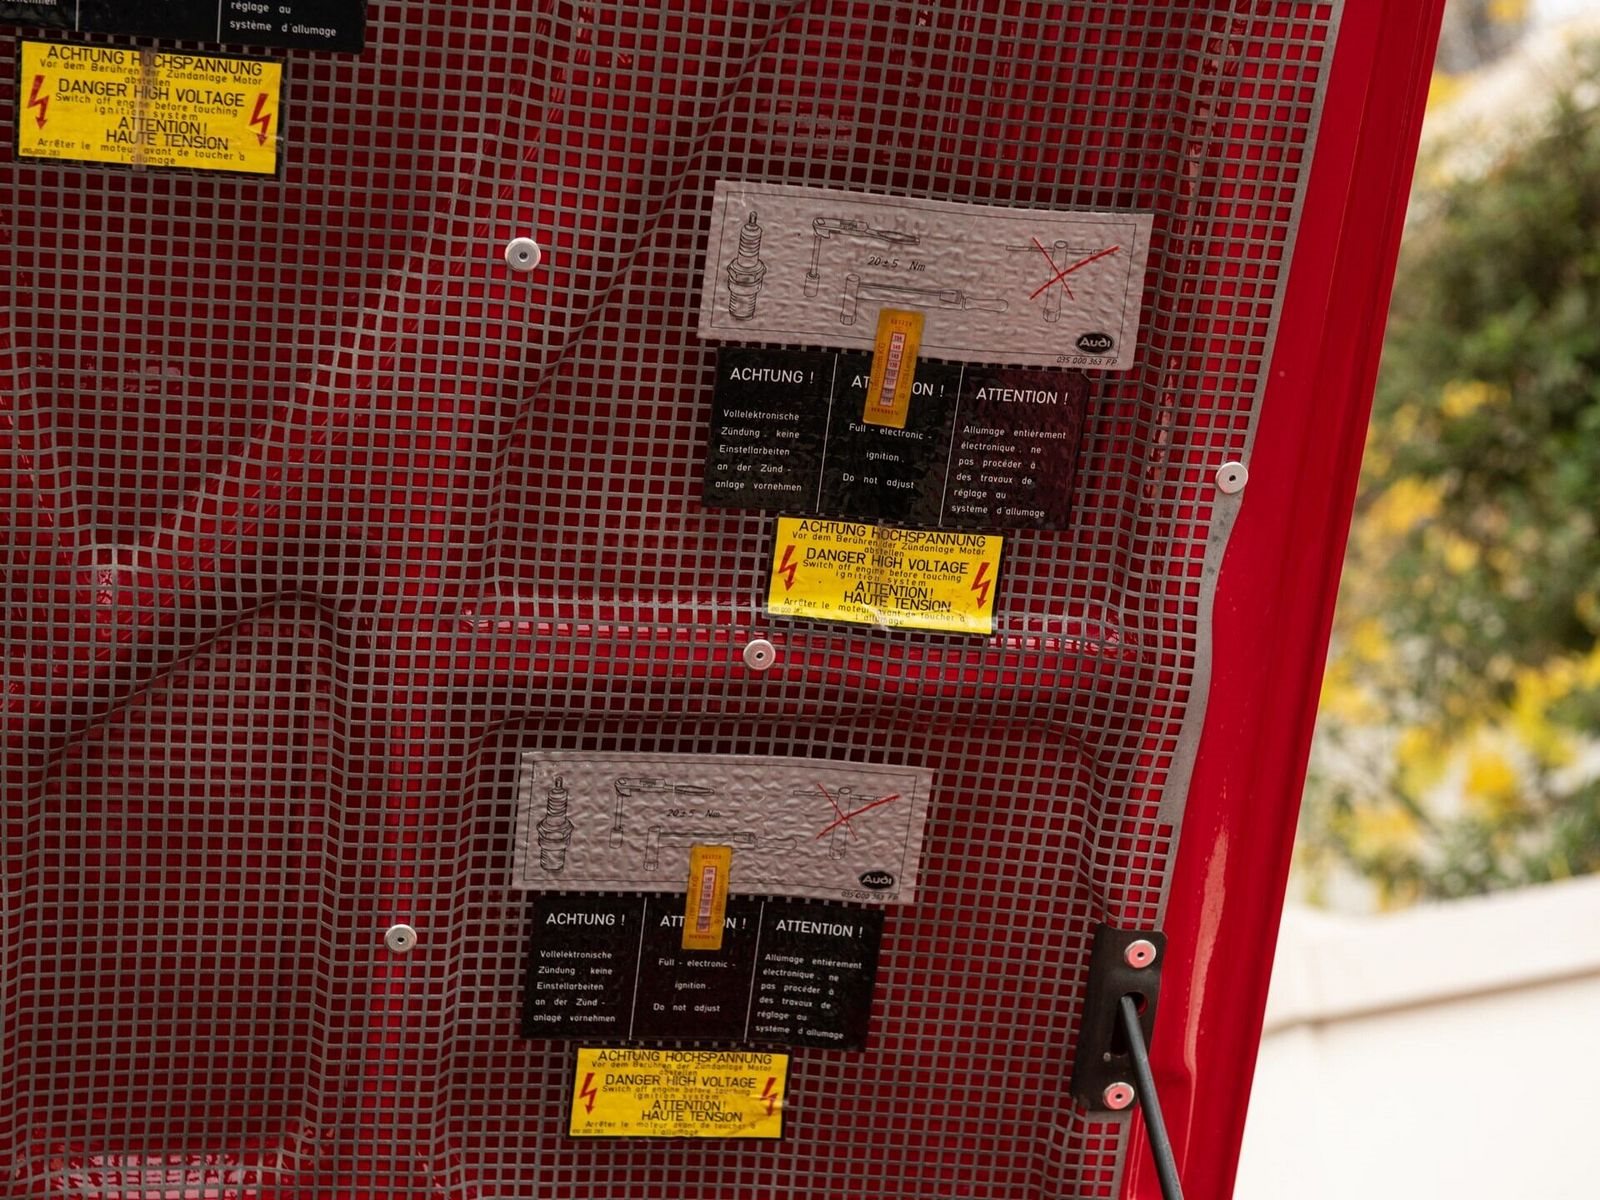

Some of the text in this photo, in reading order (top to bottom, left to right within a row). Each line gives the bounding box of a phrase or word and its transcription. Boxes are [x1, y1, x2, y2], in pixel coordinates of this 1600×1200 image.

[230, 0, 292, 14] réglage au
[230, 20, 272, 31] système
[48, 46, 263, 76] ACHTUNG HOCHSPANNUNG
[40, 58, 57, 68] Vor
[64, 60, 85, 70] dem
[91, 62, 140, 74] Berühren
[167, 70, 228, 84] Zündanlage
[233, 75, 263, 86] Motor
[58, 78, 246, 107] DANGER HIGH VOLTAGE
[56, 92, 91, 104] Switch
[154, 100, 188, 112] before
[194, 104, 238, 117] touching
[153, 110, 198, 121] system
[106, 128, 228, 150] HAUTE TENSION
[38, 138, 76, 149] Arrêter
[82, 141, 91, 150] le
[177, 148, 189, 157] de
[194, 151, 234, 160] toucher
[908, 260, 926, 272] Nm
[1080, 336, 1111, 348] Audi
[730, 367, 804, 384] ACHTUNG
[976, 386, 1058, 404] ATTENTION
[723, 409, 800, 420] Vollelektronische
[776, 430, 800, 438] keine
[963, 425, 1067, 440] Allumage entièrement
[719, 444, 790, 456] Einstellarbeiten
[1030, 446, 1042, 454] ne
[736, 462, 752, 472] der
[958, 458, 974, 466] pas
[982, 458, 1022, 469] procéder
[842, 472, 914, 489] Do not adjust
[956, 472, 1032, 485] des travaux de
[715, 480, 802, 492] anlage vornehmen
[954, 488, 1006, 500] réglage au
[951, 504, 988, 514] système
[799, 520, 986, 548] ACHTUNG HOCHSPANNUNG
[792, 531, 807, 539] Vor
[812, 533, 832, 541] dem
[836, 535, 878, 546] Berühren
[901, 542, 954, 554] Zündanlage
[960, 547, 986, 556] Motor
[864, 547, 905, 558] abstellen
[806, 547, 970, 574] DANGER HIGH VOLTAGE
[802, 560, 834, 569] Switch
[856, 566, 885, 576] engine
[889, 570, 918, 578] before
[922, 572, 962, 584] touching
[836, 570, 926, 587] ignition system
[822, 601, 830, 610] le
[843, 590, 952, 613] HAUTE TENSION
[862, 874, 893, 885] Audi
[546, 912, 616, 926] ACHTUNG
[775, 920, 854, 938] ATTENTION
[540, 950, 613, 959] Vollelektronische
[764, 953, 862, 969] Allumage entièrement
[590, 967, 613, 976] keine
[828, 974, 840, 982] ne
[536, 982, 604, 991] Einstellarbeiten
[783, 984, 820, 994] procéder
[554, 998, 568, 1006] der
[652, 1002, 721, 1014] Do not adjust
[759, 996, 832, 1010] des travaux de
[533, 1014, 616, 1023] anlage vornehmen
[756, 1010, 790, 1020] réglage
[755, 1025, 790, 1034] système
[597, 1050, 772, 1064] ACHTUNG HOCHSPANNUNG
[592, 1060, 606, 1068] Vor
[605, 1074, 757, 1089] DANGER HIGH VOLTAGE
[641, 1110, 744, 1122] HAUTE TENSION
